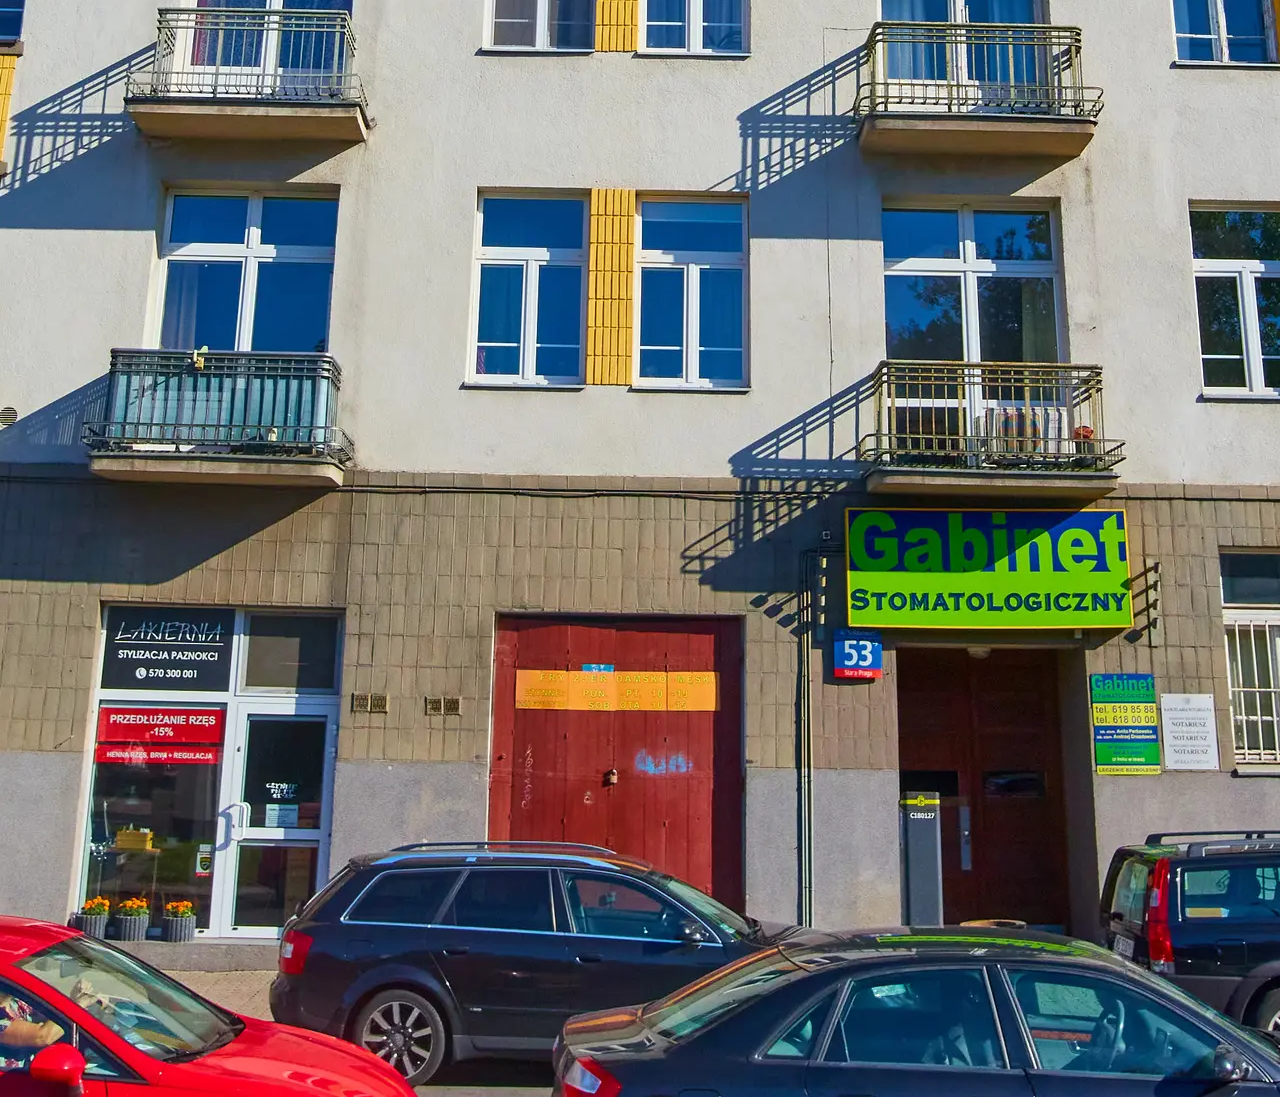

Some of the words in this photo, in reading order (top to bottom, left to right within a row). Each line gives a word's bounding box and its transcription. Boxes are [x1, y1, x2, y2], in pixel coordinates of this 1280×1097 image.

[849, 511, 1127, 573] Gabinet
[850, 589, 1127, 612] STOMATOLOGICZNY
[115, 621, 224, 641] LAKIERNIA
[118, 650, 169, 660] STYLIZACJA
[171, 651, 218, 661] PAZNOKCI
[844, 640, 873, 666] 53
[148, 668, 164, 678] 570
[165, 669, 181, 678] 300
[182, 670, 198, 678] 001
[1091, 674, 1154, 692] Gabinet
[1095, 705, 1109, 714] tel.
[1112, 705, 1128, 714] 619
[1130, 705, 1141, 714] 85
[1143, 705, 1155, 714] 88
[109, 713, 187, 725] PRZEDŁUŻANIE
[189, 715, 216, 727] RZĘS
[1095, 715, 1112, 724] tel.
[1112, 716, 1129, 724] 618
[1131, 716, 1142, 724] 00
[1144, 716, 1155, 724] 00
[150, 727, 174, 736] -15%
